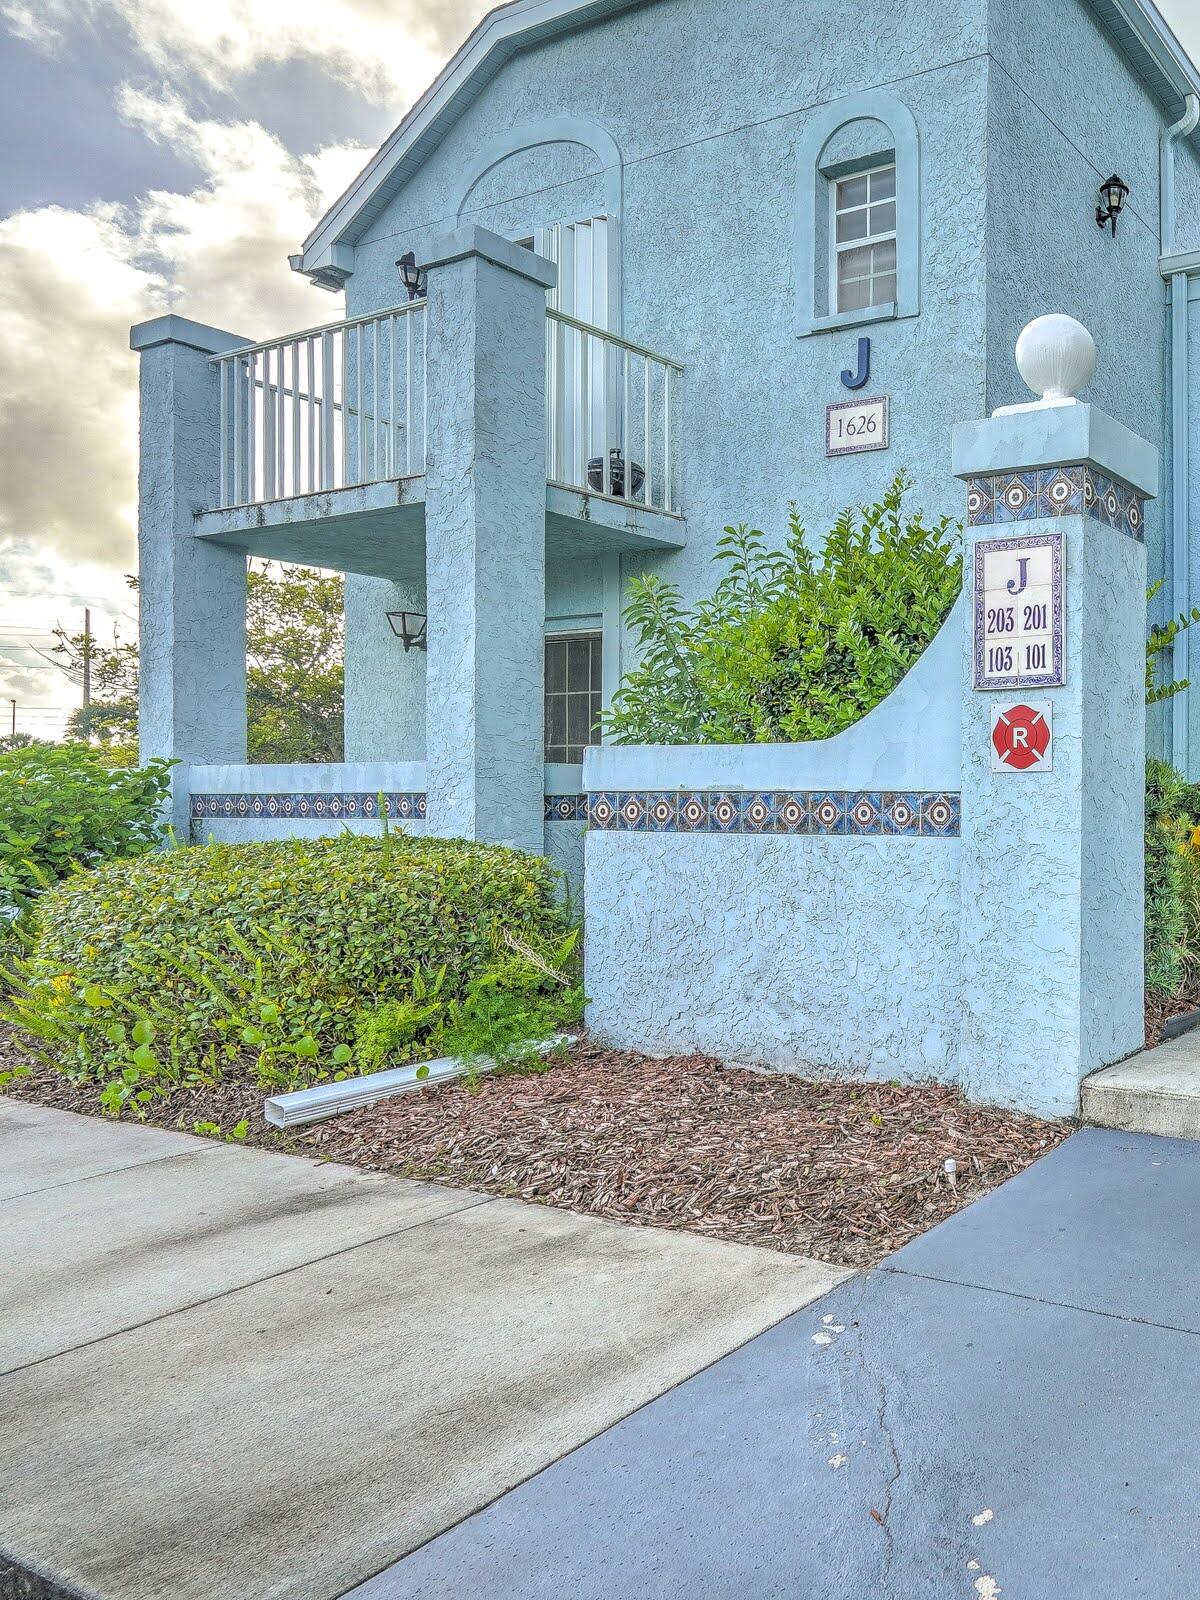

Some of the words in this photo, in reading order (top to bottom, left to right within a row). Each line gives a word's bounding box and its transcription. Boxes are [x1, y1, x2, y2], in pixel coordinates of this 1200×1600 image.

[841, 337, 870, 390] J
[838, 413, 876, 437] 1626
[1007, 557, 1031, 595] J
[987, 607, 1014, 633] 203
[1023, 604, 1047, 631] 201
[988, 646, 1013, 673] 103
[1025, 643, 1046, 670] 101
[1013, 727, 1029, 748] R
